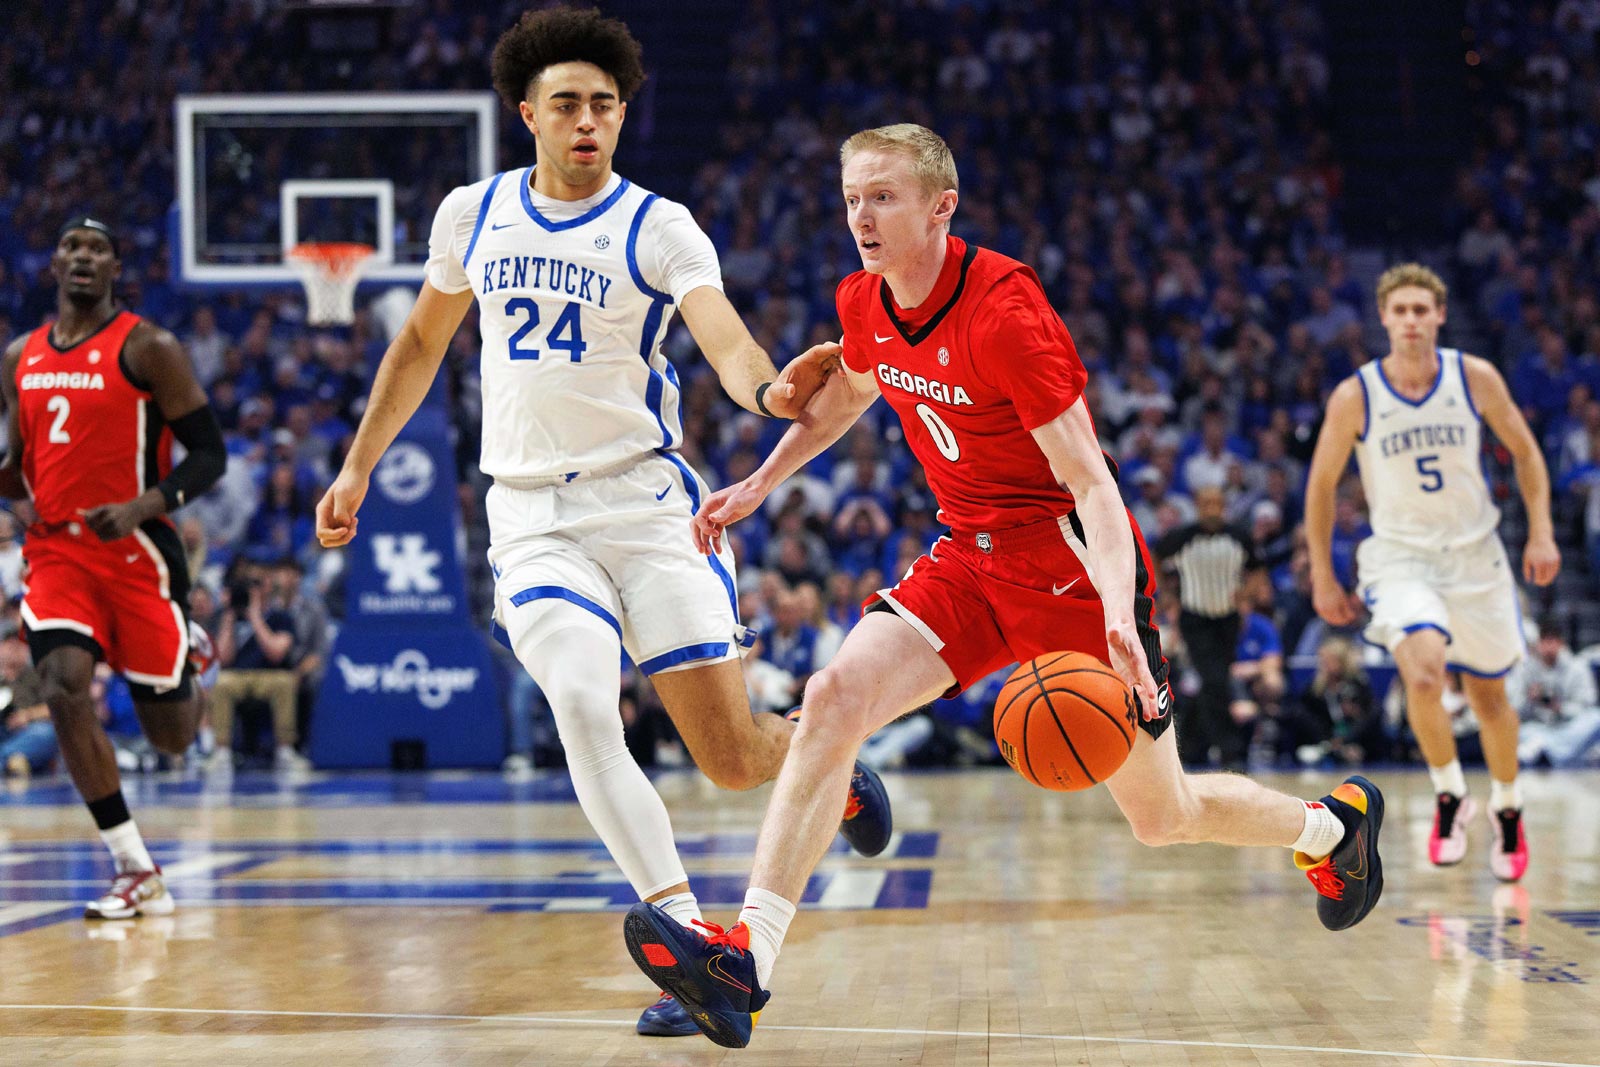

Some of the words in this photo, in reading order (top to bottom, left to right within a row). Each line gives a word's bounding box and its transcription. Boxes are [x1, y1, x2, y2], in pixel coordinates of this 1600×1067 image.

[483, 256, 612, 309] KENTUCKY
[504, 297, 587, 363] 24
[21, 371, 105, 391] GEORGIA
[877, 363, 975, 406] GEORGIA
[47, 394, 71, 444] 2
[915, 402, 960, 462] 0
[1381, 424, 1466, 459] KENTUCKY
[1415, 455, 1444, 492] 5
[371, 533, 442, 592] UK
